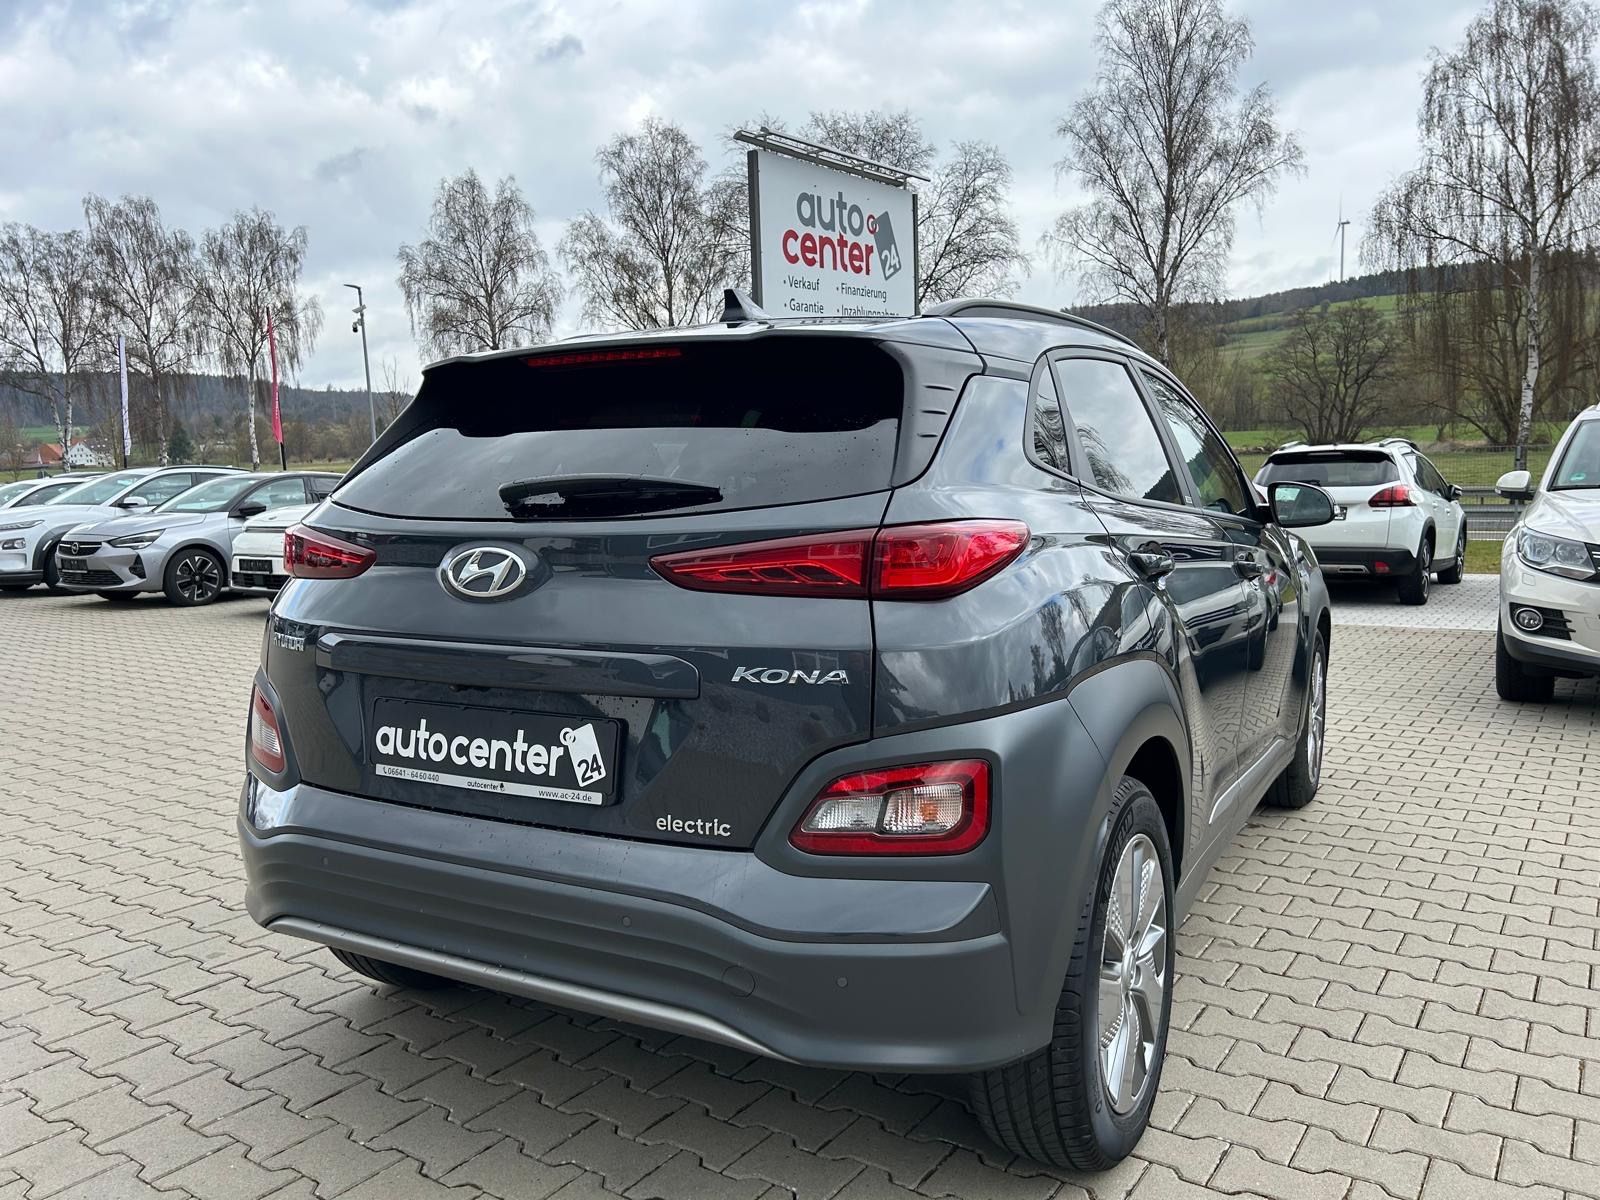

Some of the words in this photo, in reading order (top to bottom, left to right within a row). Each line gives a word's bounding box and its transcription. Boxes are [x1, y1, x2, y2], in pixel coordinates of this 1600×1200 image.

[796, 191, 864, 237] auto
[782, 229, 873, 275] center
[881, 244, 900, 278] 24
[788, 275, 820, 291] Verkauf
[841, 283, 887, 303] Finanzierung
[789, 298, 824, 314] Garantie
[731, 666, 849, 685] KONA
[375, 718, 564, 777] autocenter
[577, 753, 602, 784] 24
[467, 781, 499, 790] autocenter
[538, 790, 592, 802] www.ac-24.de
[656, 814, 731, 837] electric
